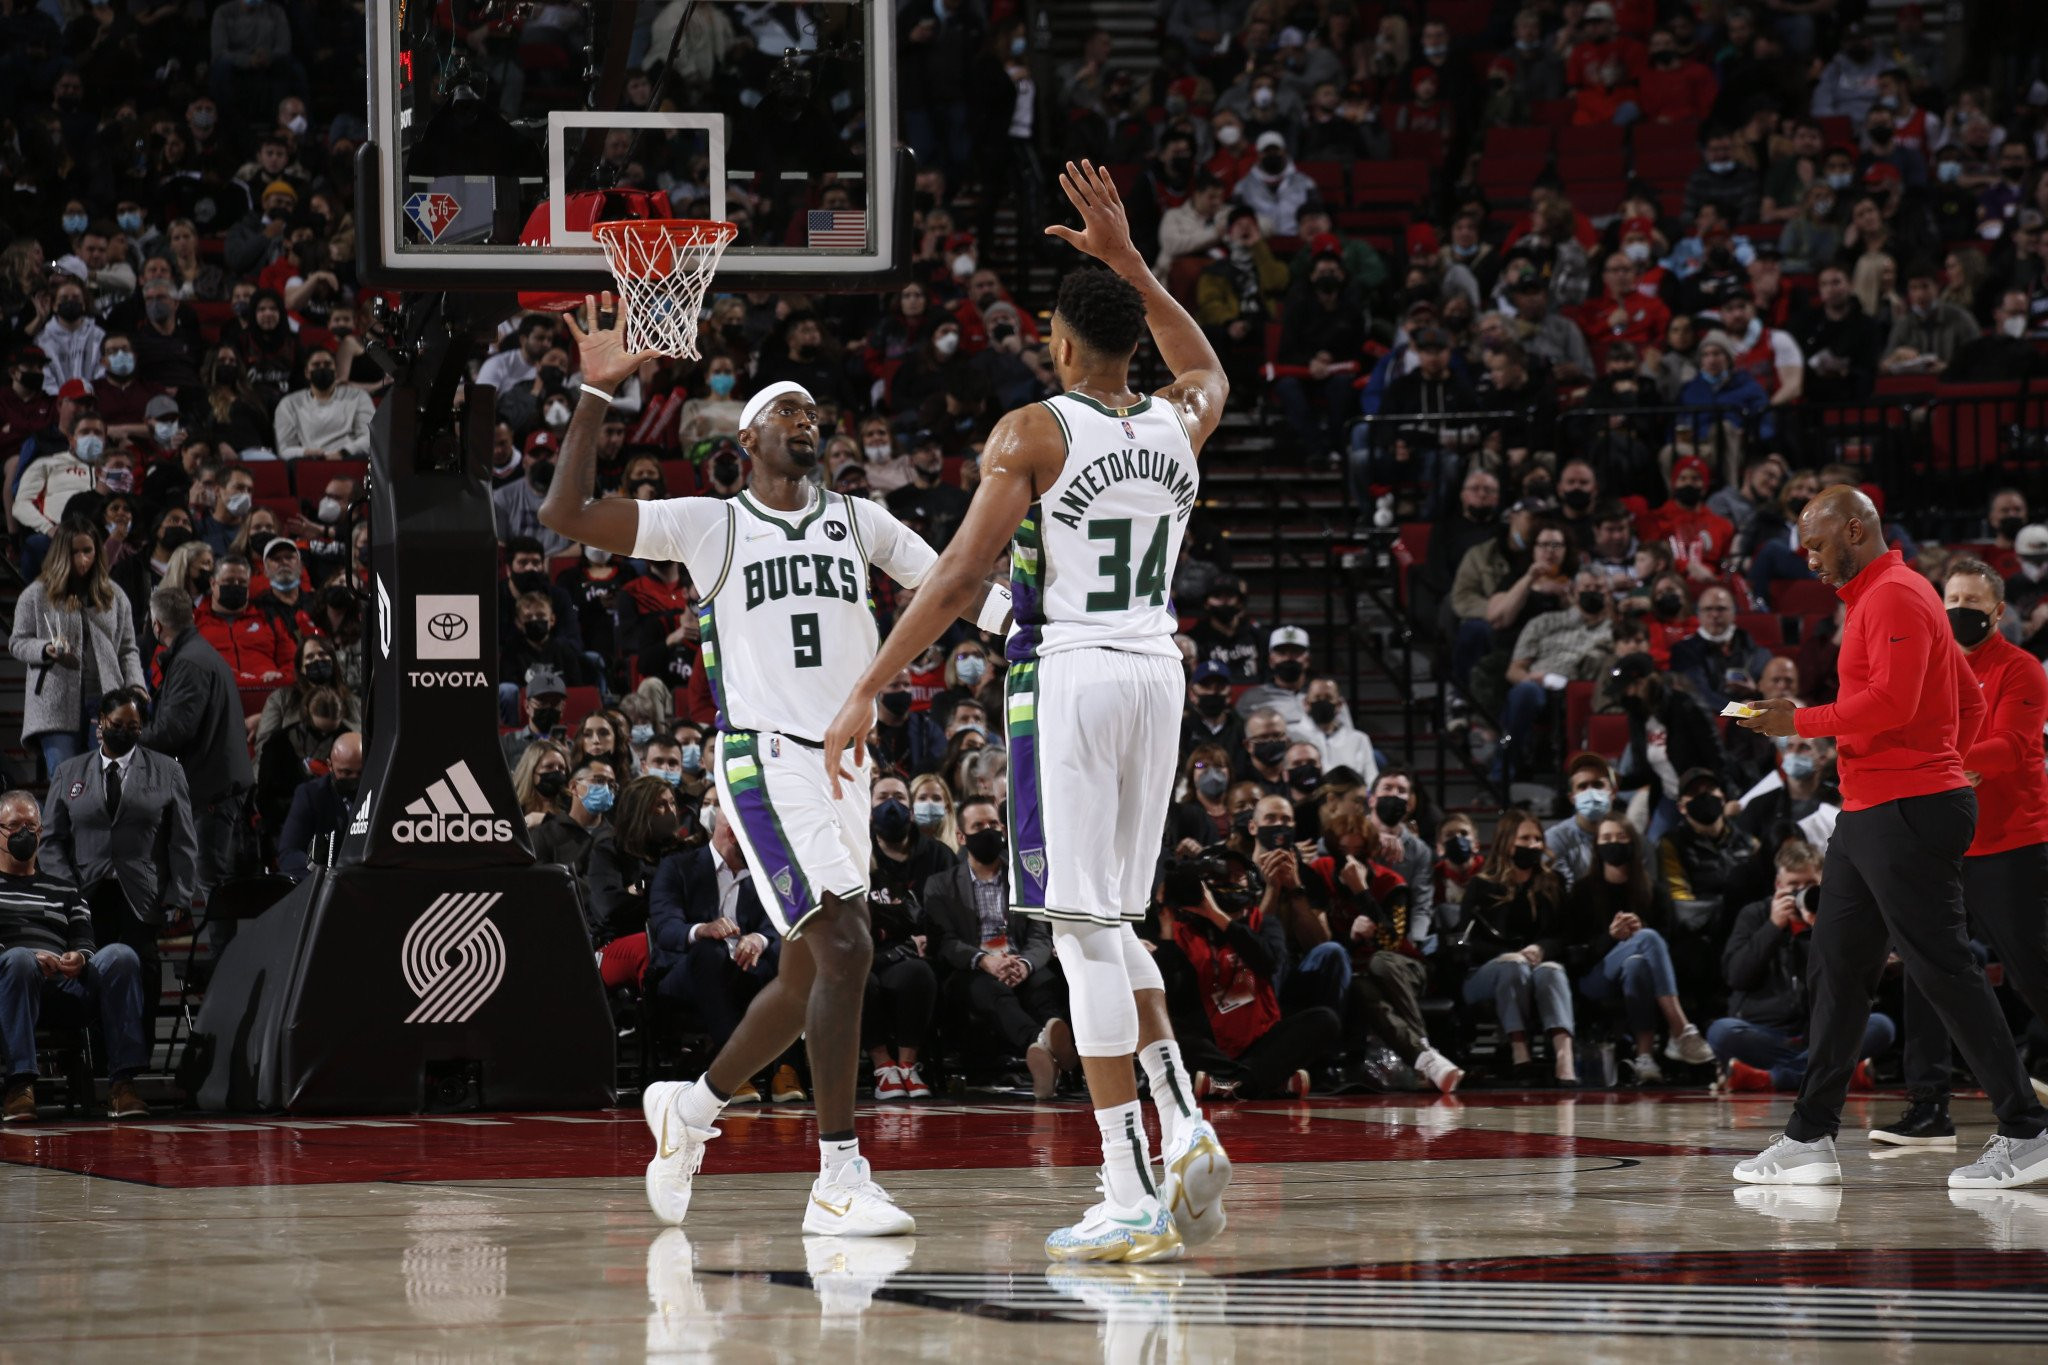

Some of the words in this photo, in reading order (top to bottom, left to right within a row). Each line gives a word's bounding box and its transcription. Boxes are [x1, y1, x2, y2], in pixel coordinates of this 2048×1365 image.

[437, 200, 449, 216] 75
[1086, 514, 1171, 613] 34
[743, 553, 859, 612] BUCKS
[791, 612, 822, 668] 9
[408, 671, 489, 688] TOYOTA
[350, 820, 369, 836] adidas
[391, 812, 514, 843] adidas
